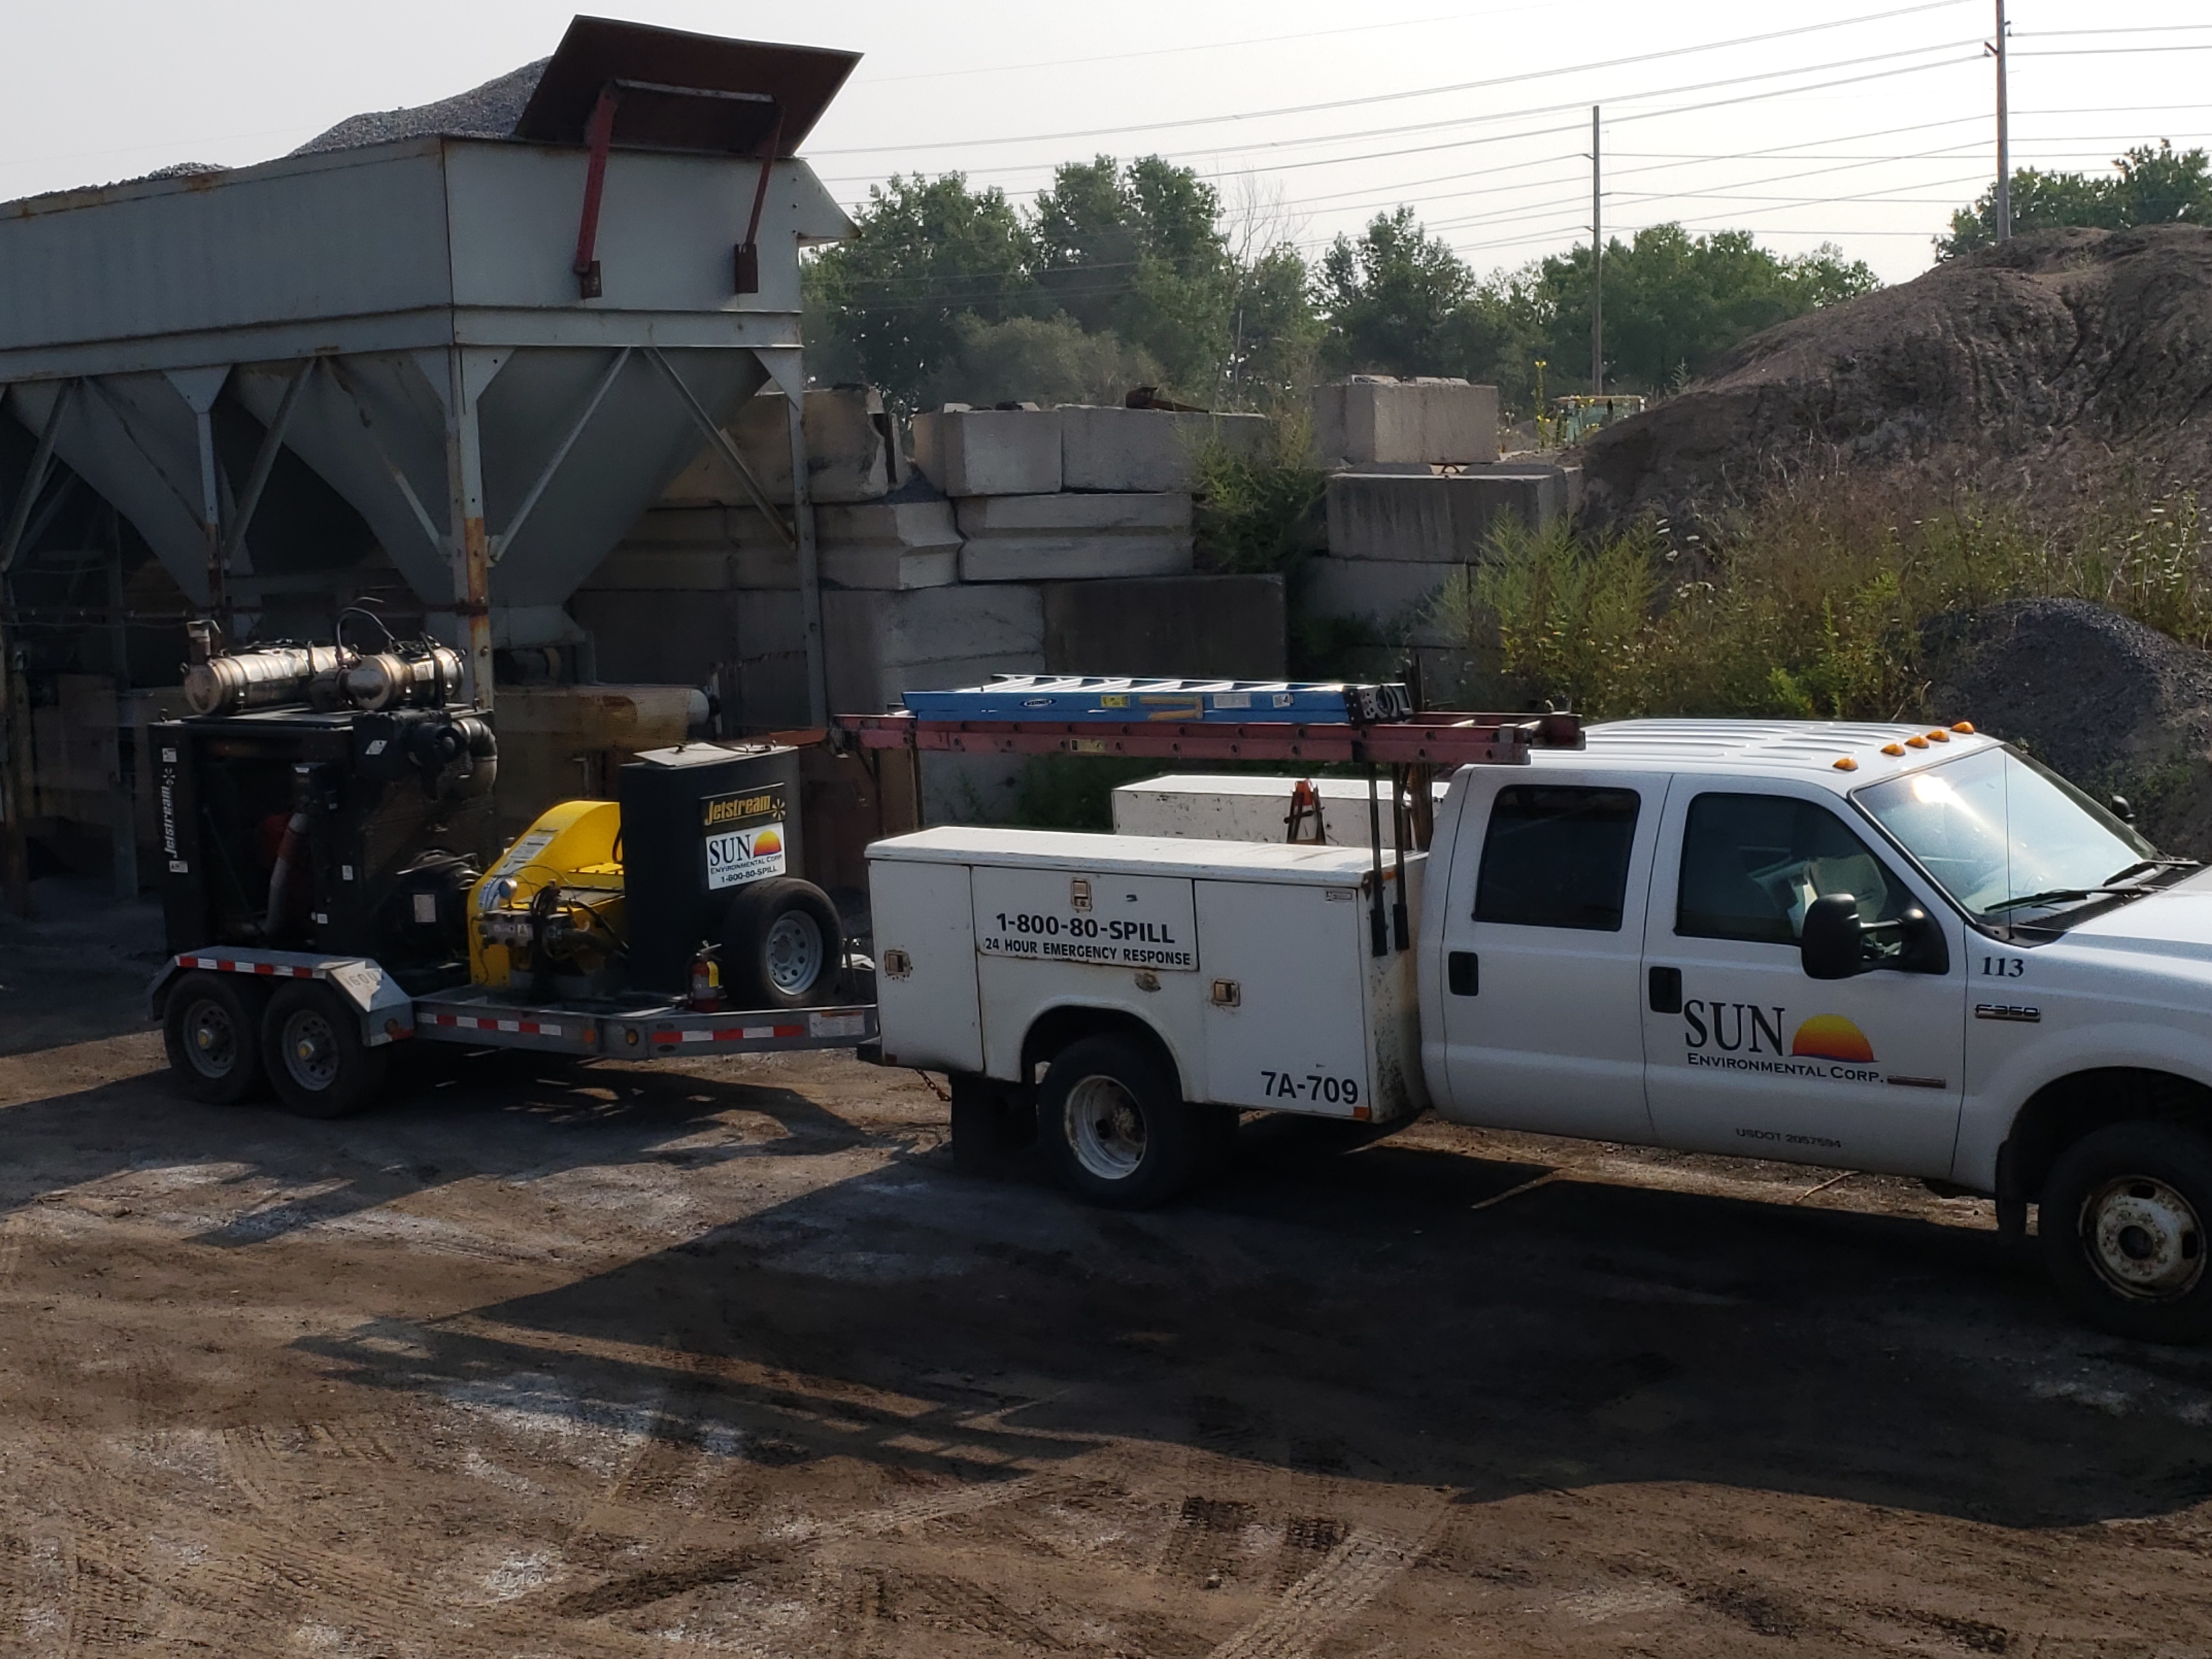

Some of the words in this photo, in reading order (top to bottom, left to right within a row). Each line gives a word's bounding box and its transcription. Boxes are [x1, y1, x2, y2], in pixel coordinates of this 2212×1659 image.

[704, 795, 770, 826] Jetstream
[709, 834, 751, 866] SUN
[996, 913, 1175, 944] 1-800-80-SPILL
[985, 938, 1000, 950] 24
[1005, 939, 1037, 953] HOUR
[1043, 942, 1117, 960] EMERGENCY
[1123, 948, 1190, 966] RESPONSE
[1981, 956, 2024, 978] 113
[1684, 1000, 1785, 1057] SUN
[1688, 1052, 1827, 1078] ENVIRONMENTAL
[1830, 1066, 1884, 1083] CORP.
[1261, 1071, 1358, 1104] 7A-709
[1736, 1128, 1781, 1141] USDOT
